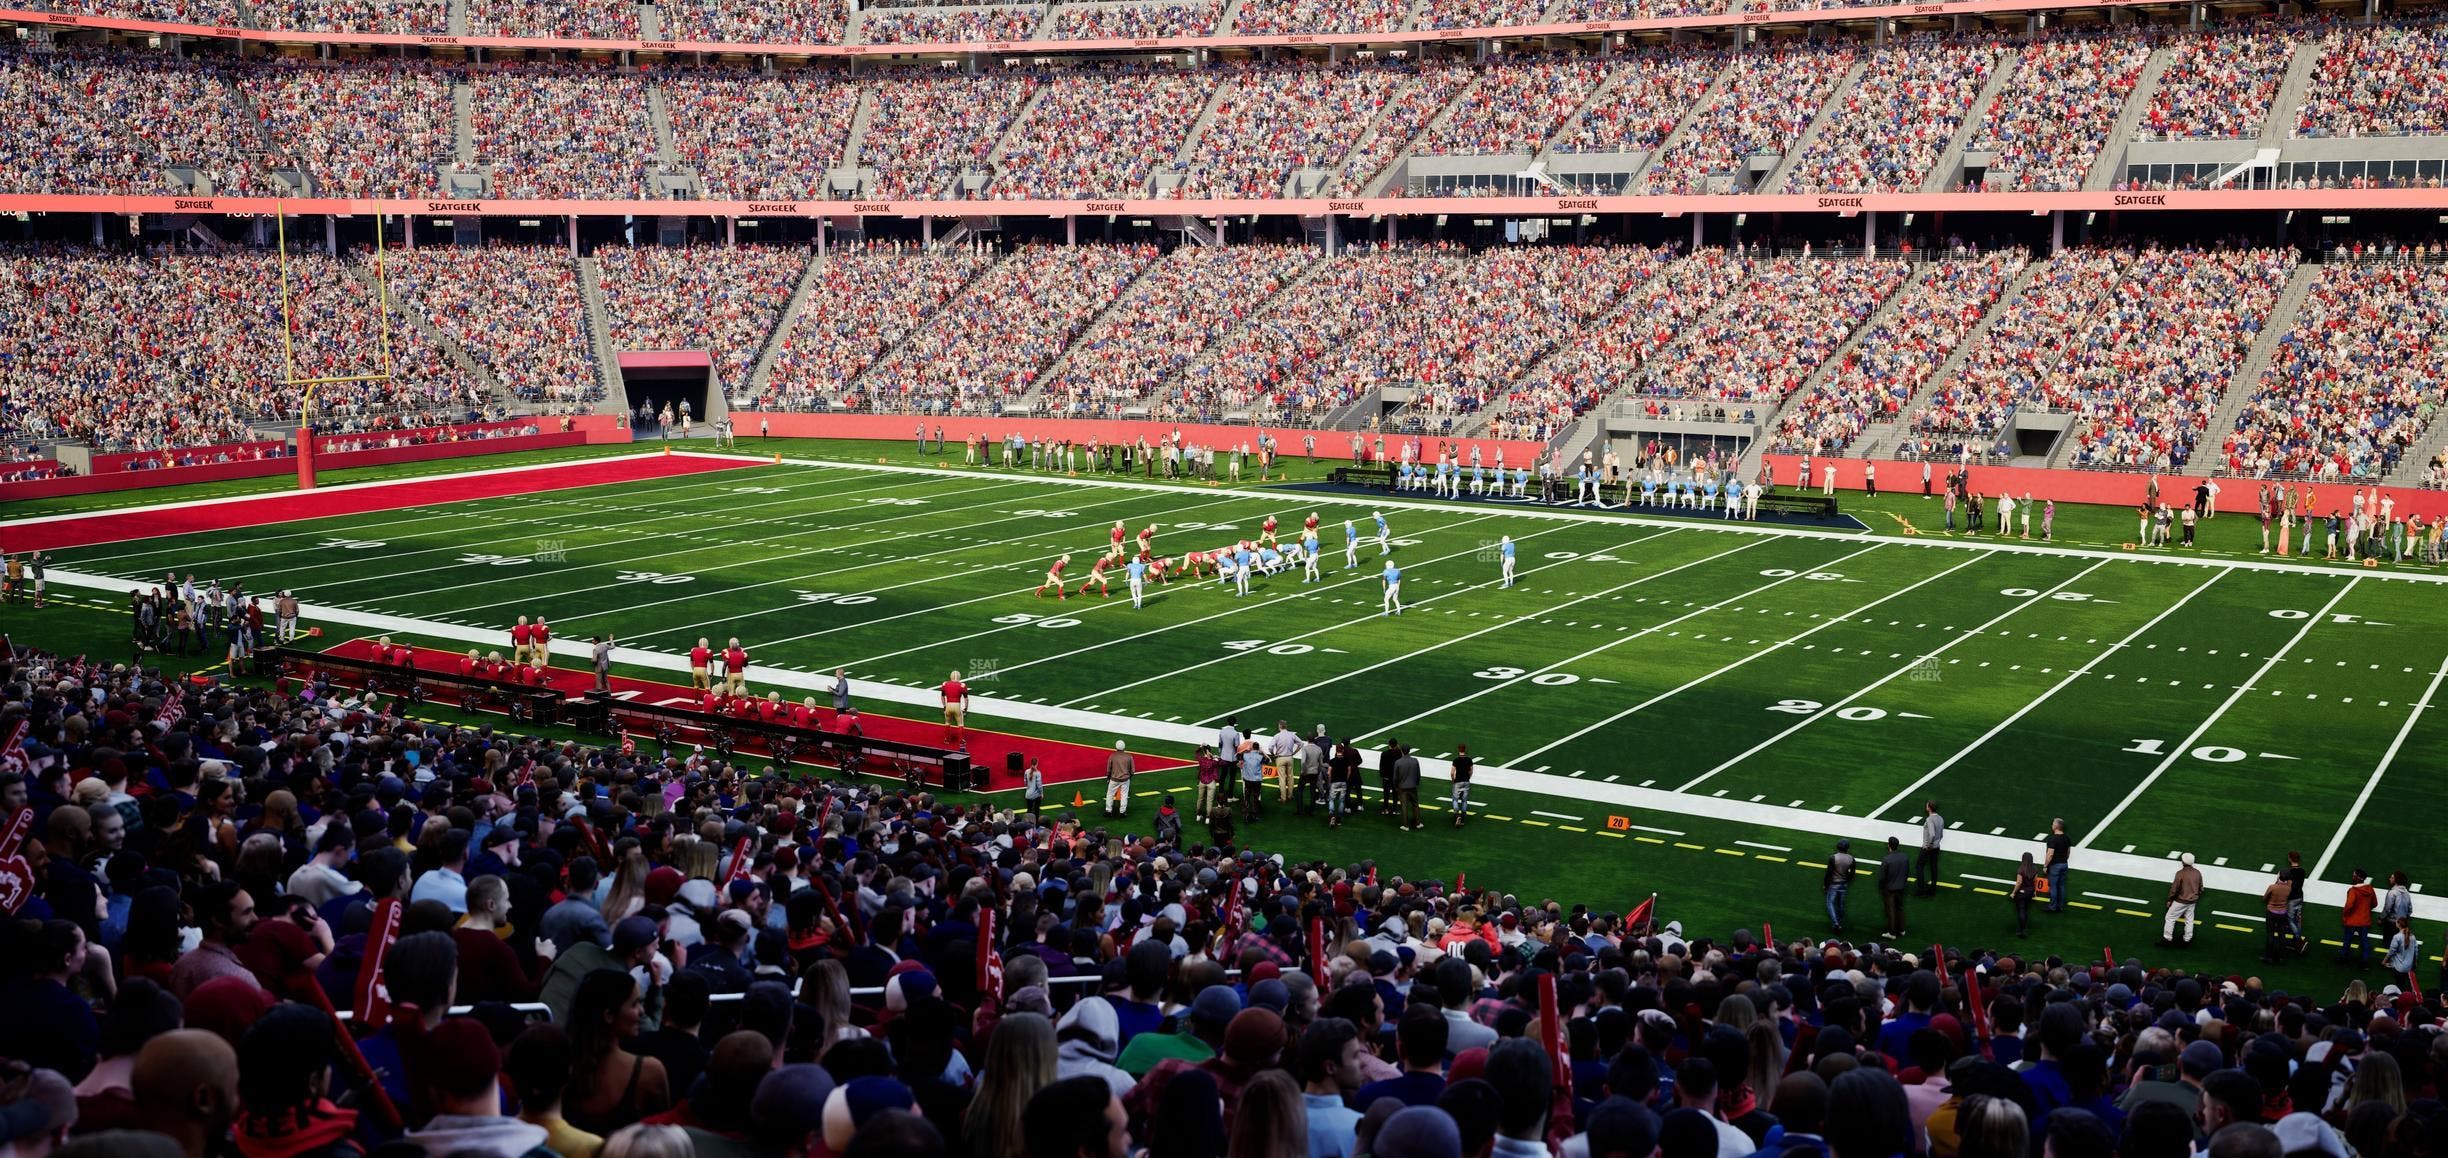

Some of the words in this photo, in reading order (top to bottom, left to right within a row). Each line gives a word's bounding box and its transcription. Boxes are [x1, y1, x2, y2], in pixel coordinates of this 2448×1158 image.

[1914, 5, 1943, 13] SEATGEEK
[49, 14, 78, 23] SEATGEEK
[216, 28, 242, 37] SEATGEEK
[174, 200, 214, 210] SEATGEEK
[1558, 200, 1599, 209] SEATGEEK
[1818, 197, 1863, 207] SEATGEEK
[2114, 195, 2166, 205] SEATGEEK
[428, 202, 482, 212] SEATGEEK
[749, 204, 797, 212] SEATGEEK
[854, 204, 890, 212] SEATGEEK
[1086, 203, 1125, 212] SEATGEEK
[1328, 202, 1364, 211] SEATGEEK
[991, 613, 1083, 628] 50
[1220, 639, 1315, 655] 40
[1473, 666, 1581, 686] 30
[1765, 699, 1887, 721] 20
[2121, 738, 2247, 763] 10
[1263, 767, 1273, 776] 30
[1613, 817, 1624, 828] 20
